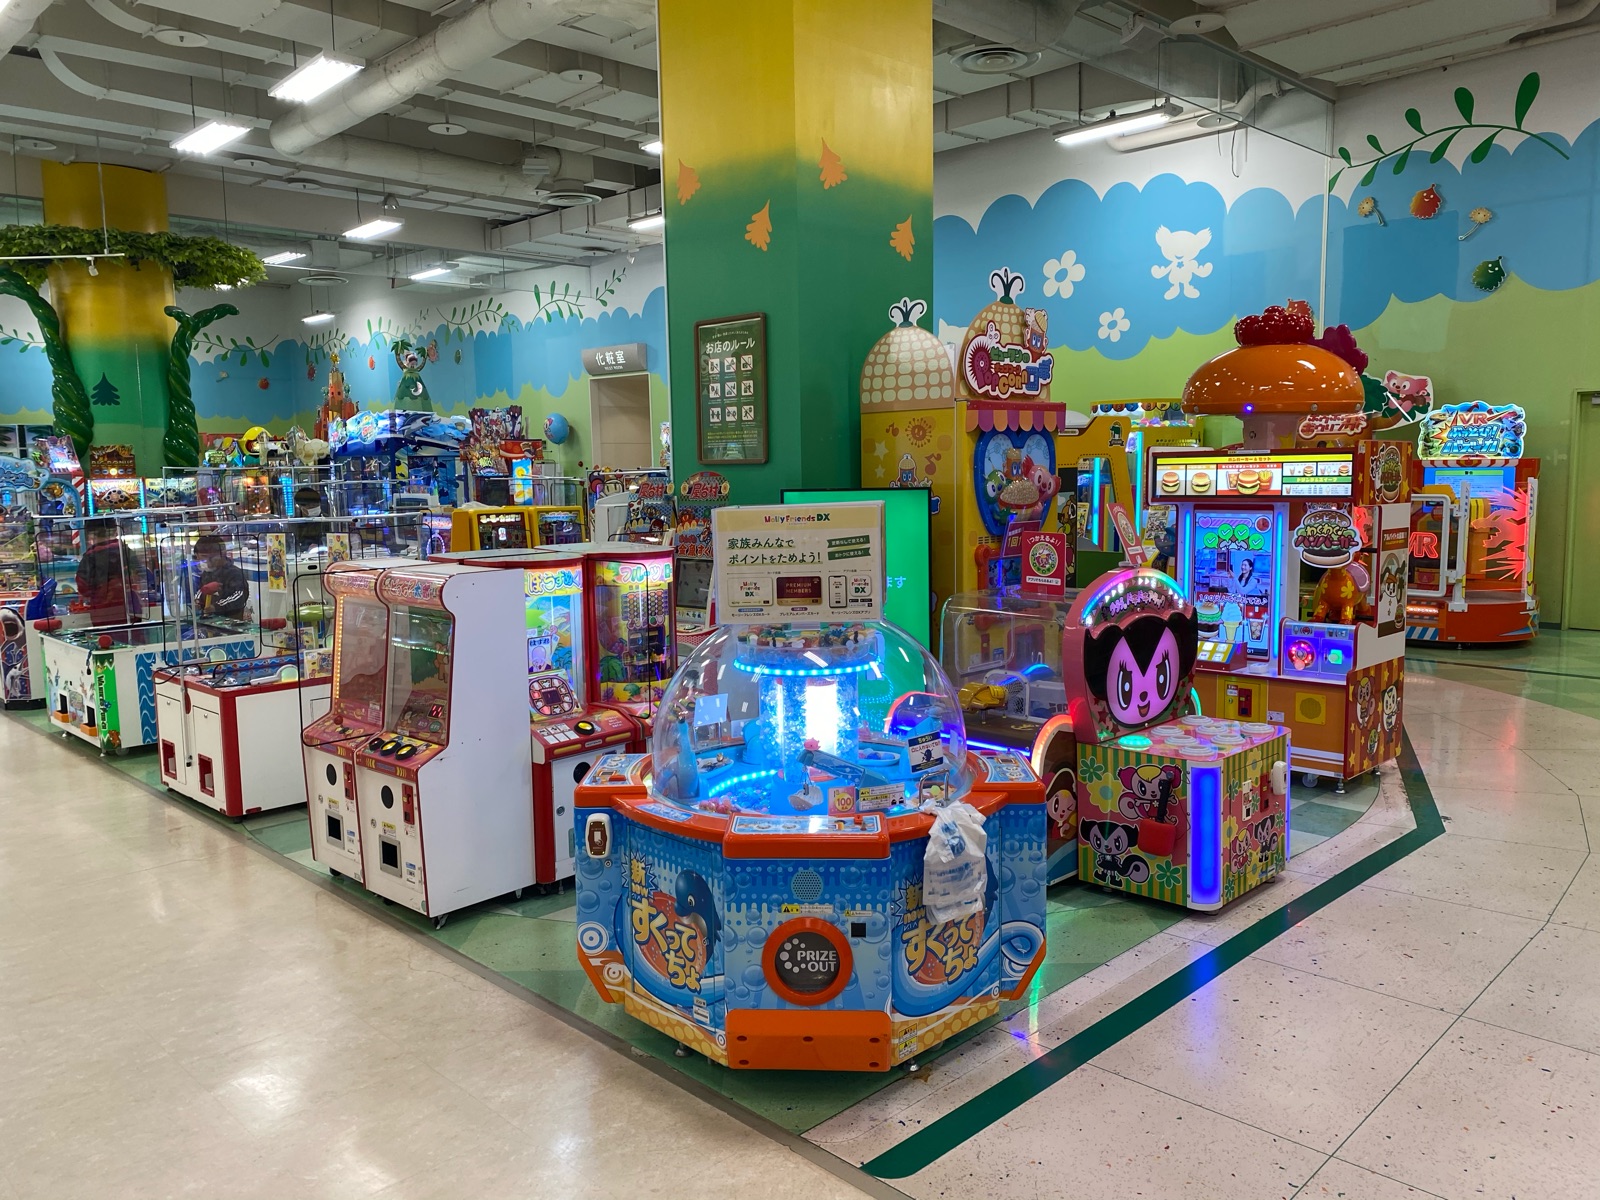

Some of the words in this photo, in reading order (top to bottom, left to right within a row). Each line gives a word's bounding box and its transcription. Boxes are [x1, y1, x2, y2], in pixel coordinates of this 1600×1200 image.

[706, 337, 755, 354] お店のルール
[595, 350, 626, 366] 化粧室
[1459, 413, 1488, 424] VR
[1442, 439, 1498, 453] バズーカ
[690, 482, 719, 498] 屋台村
[816, 513, 830, 521] DX
[727, 537, 795, 550] 家族みんなで
[1294, 535, 1359, 549] ハンバーガー
[729, 551, 821, 565] ポイントをためよう!
[837, 797, 852, 806] 100
[631, 858, 646, 886] 新
[797, 950, 837, 961] PRIZE
[807, 961, 837, 972] OUT
